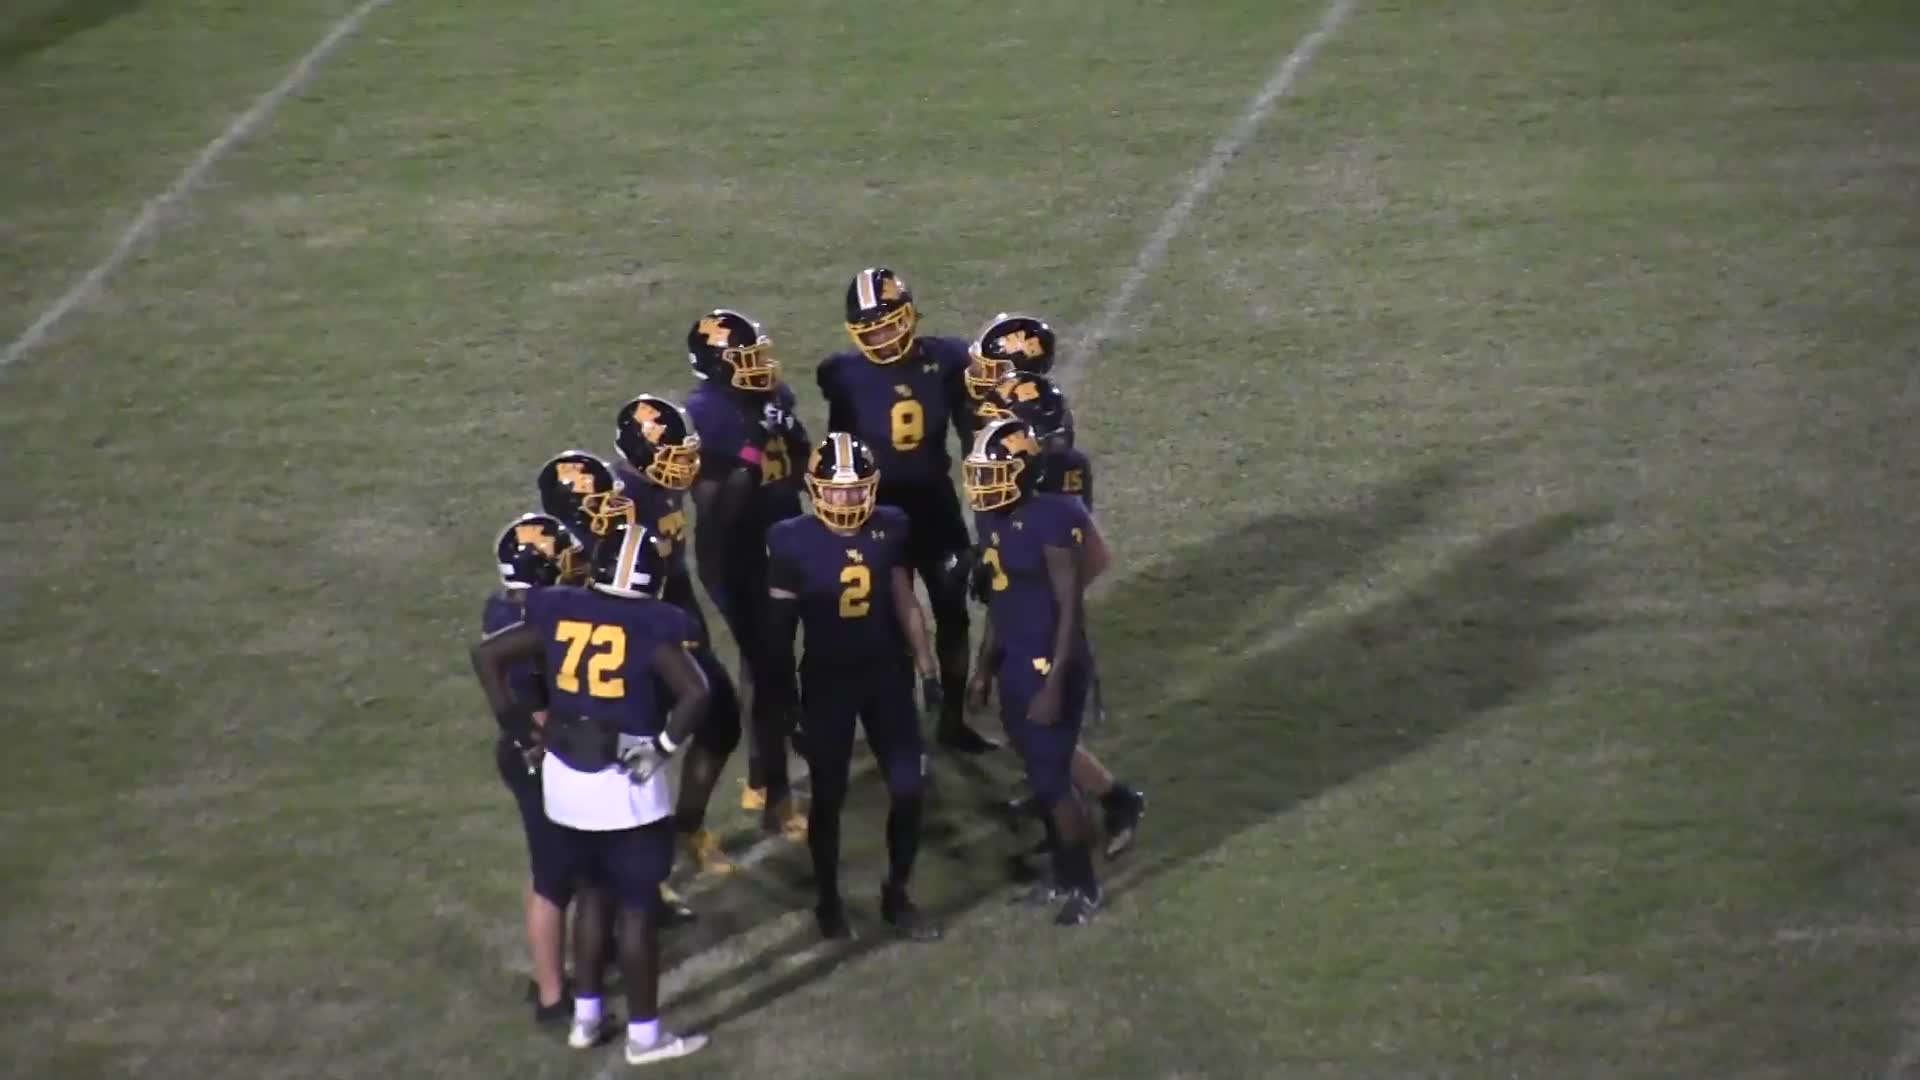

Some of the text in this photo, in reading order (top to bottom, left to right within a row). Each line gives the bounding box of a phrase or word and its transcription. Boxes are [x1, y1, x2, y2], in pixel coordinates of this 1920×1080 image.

[890, 399, 924, 451] 8
[839, 564, 871, 618] 2
[555, 619, 627, 698] 72
